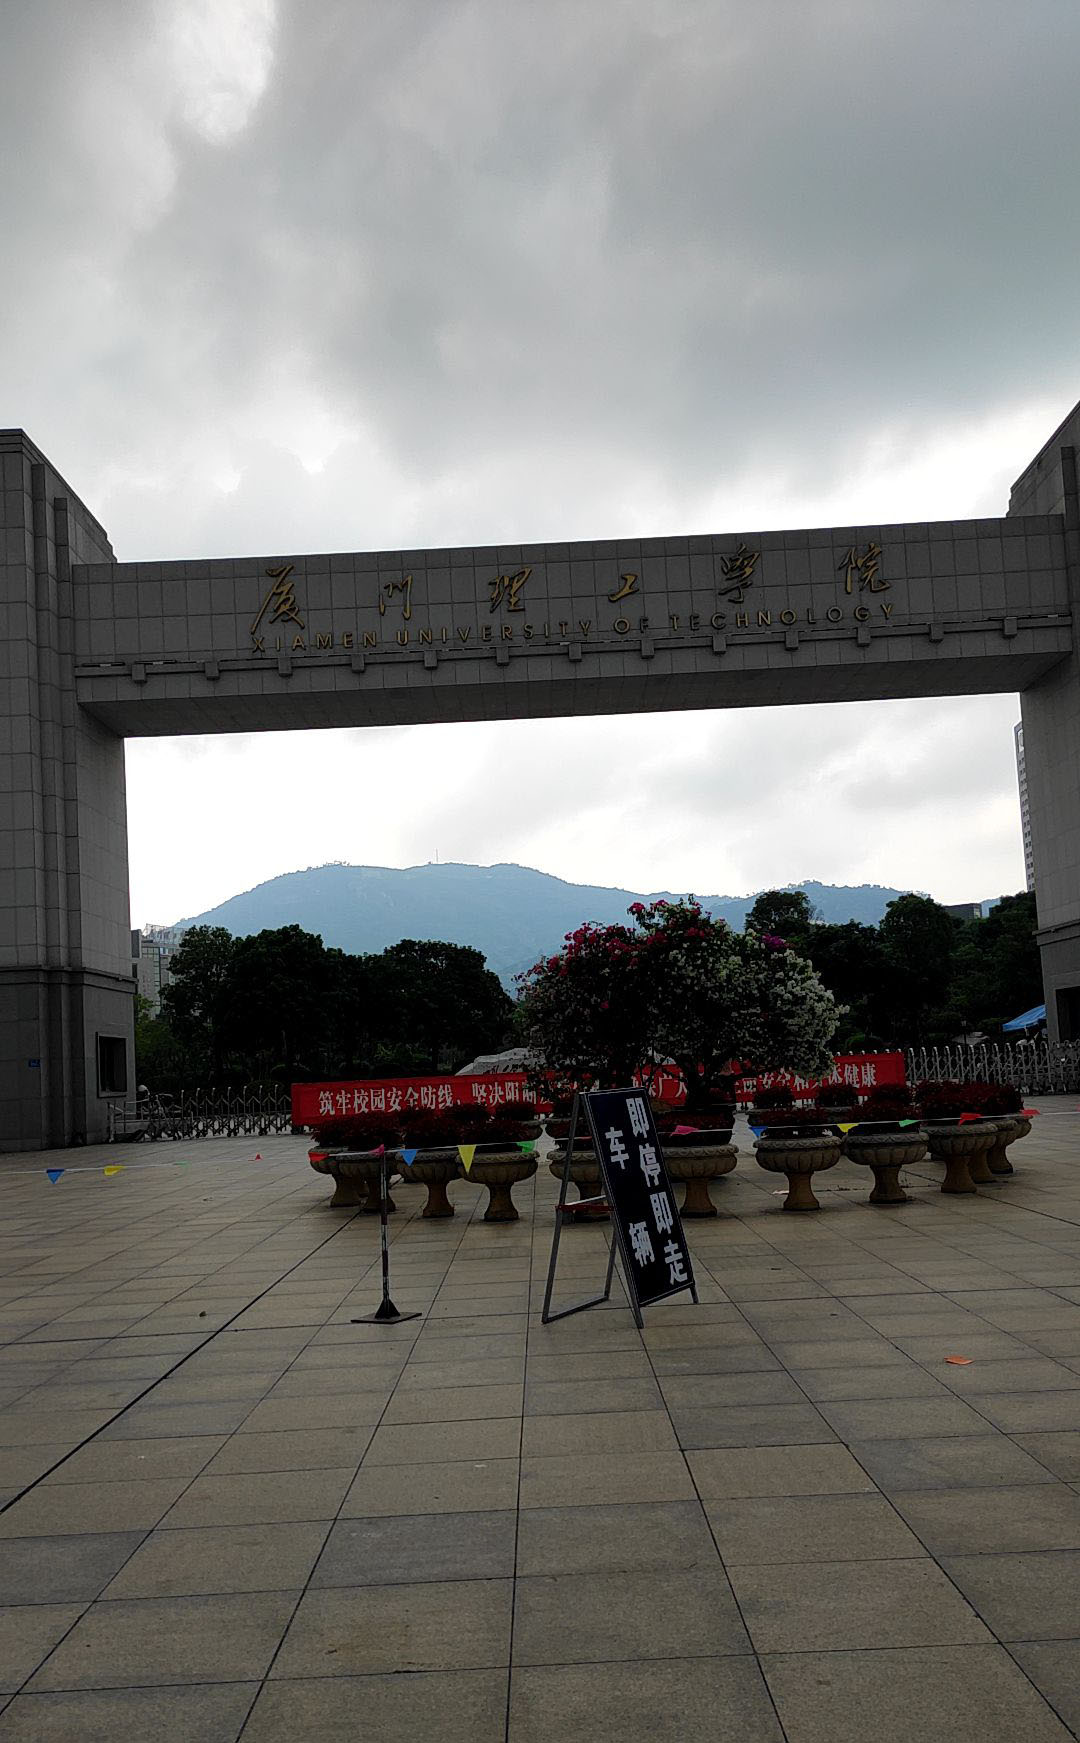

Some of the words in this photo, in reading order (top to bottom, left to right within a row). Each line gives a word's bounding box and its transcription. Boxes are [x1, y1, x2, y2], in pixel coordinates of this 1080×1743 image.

[251, 631, 378, 653] XIAMEN
[396, 619, 592, 646] UNIVERSITY
[613, 616, 650, 634] OF
[669, 603, 894, 632] TECHNOLOGY
[605, 1126, 656, 1268] 车辆
[625, 1096, 689, 1286] 即停即走
